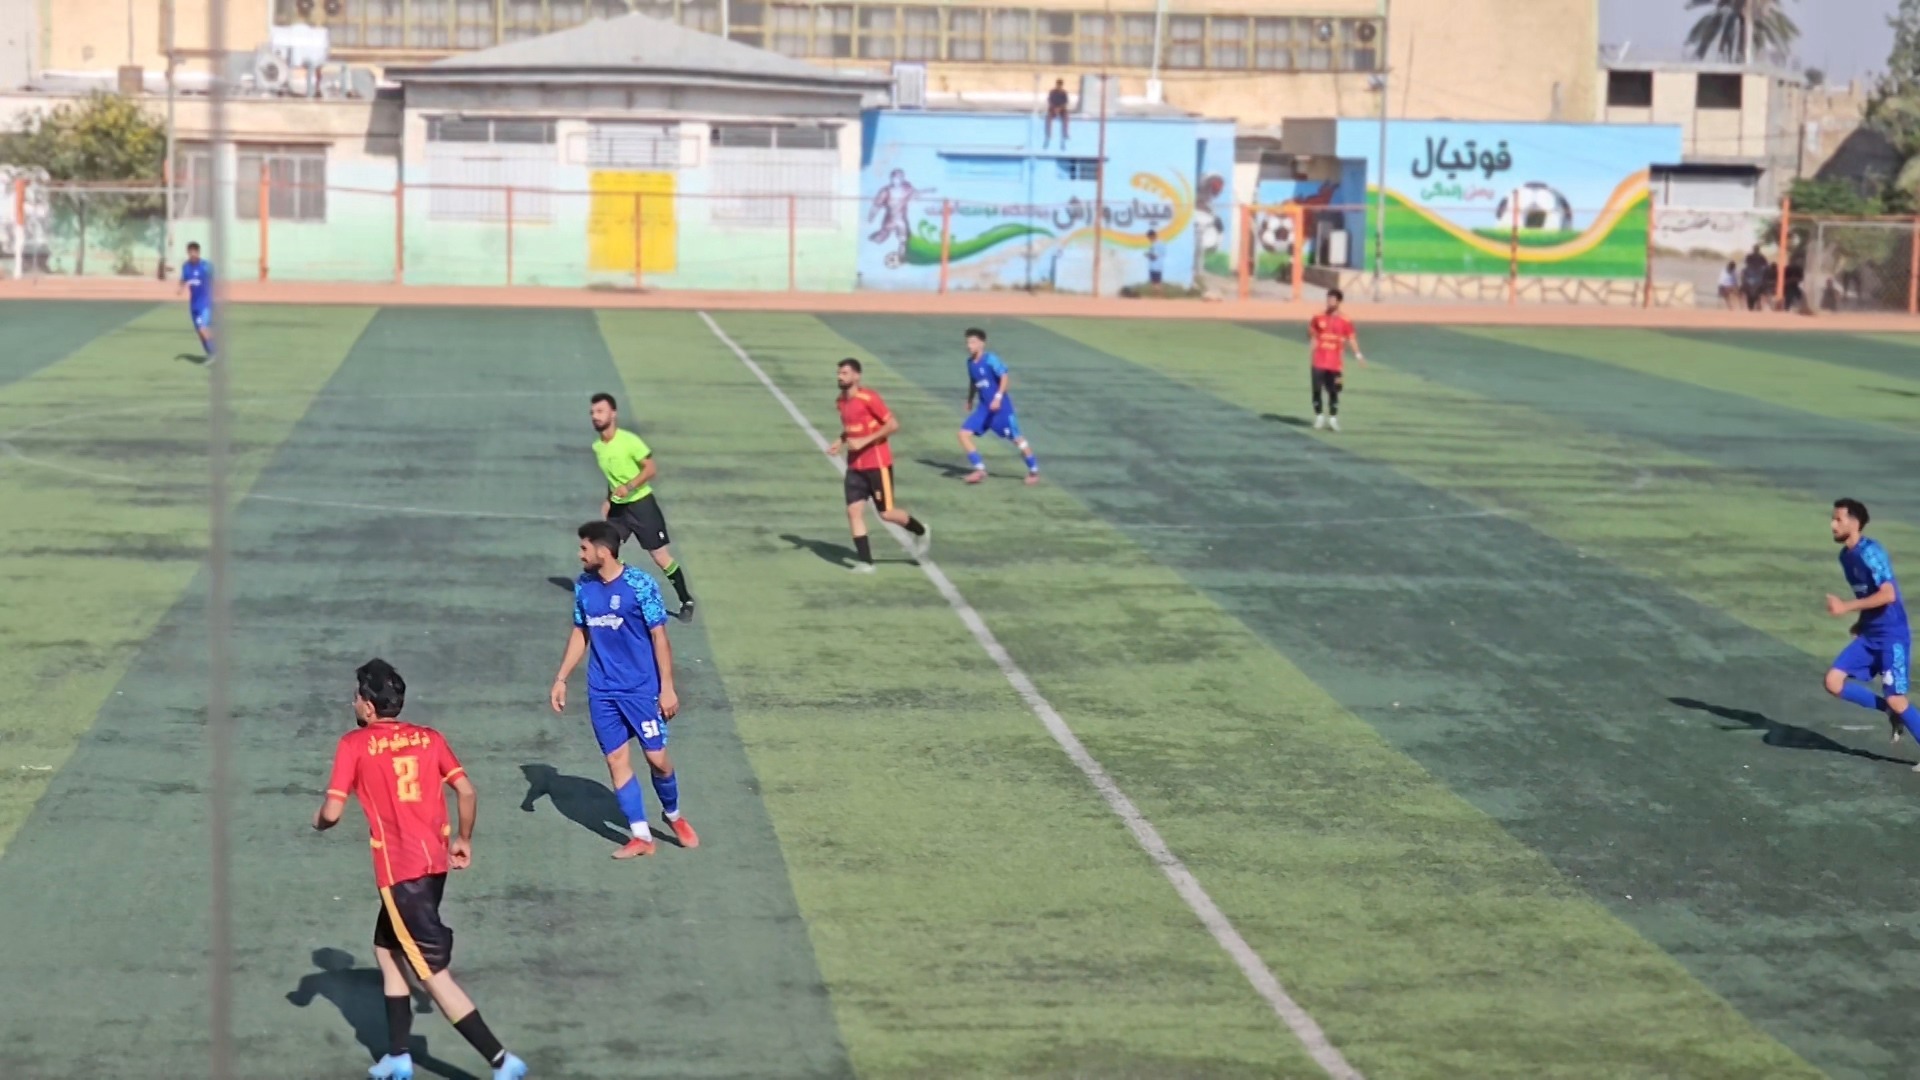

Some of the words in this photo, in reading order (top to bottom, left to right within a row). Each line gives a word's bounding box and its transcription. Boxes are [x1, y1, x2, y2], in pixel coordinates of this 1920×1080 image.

[1411, 135, 1512, 180] فوتبال
[1052, 195, 1112, 229] وزش
[1115, 197, 1172, 227] میدان
[641, 719, 660, 738] 51
[392, 756, 422, 802] 2
